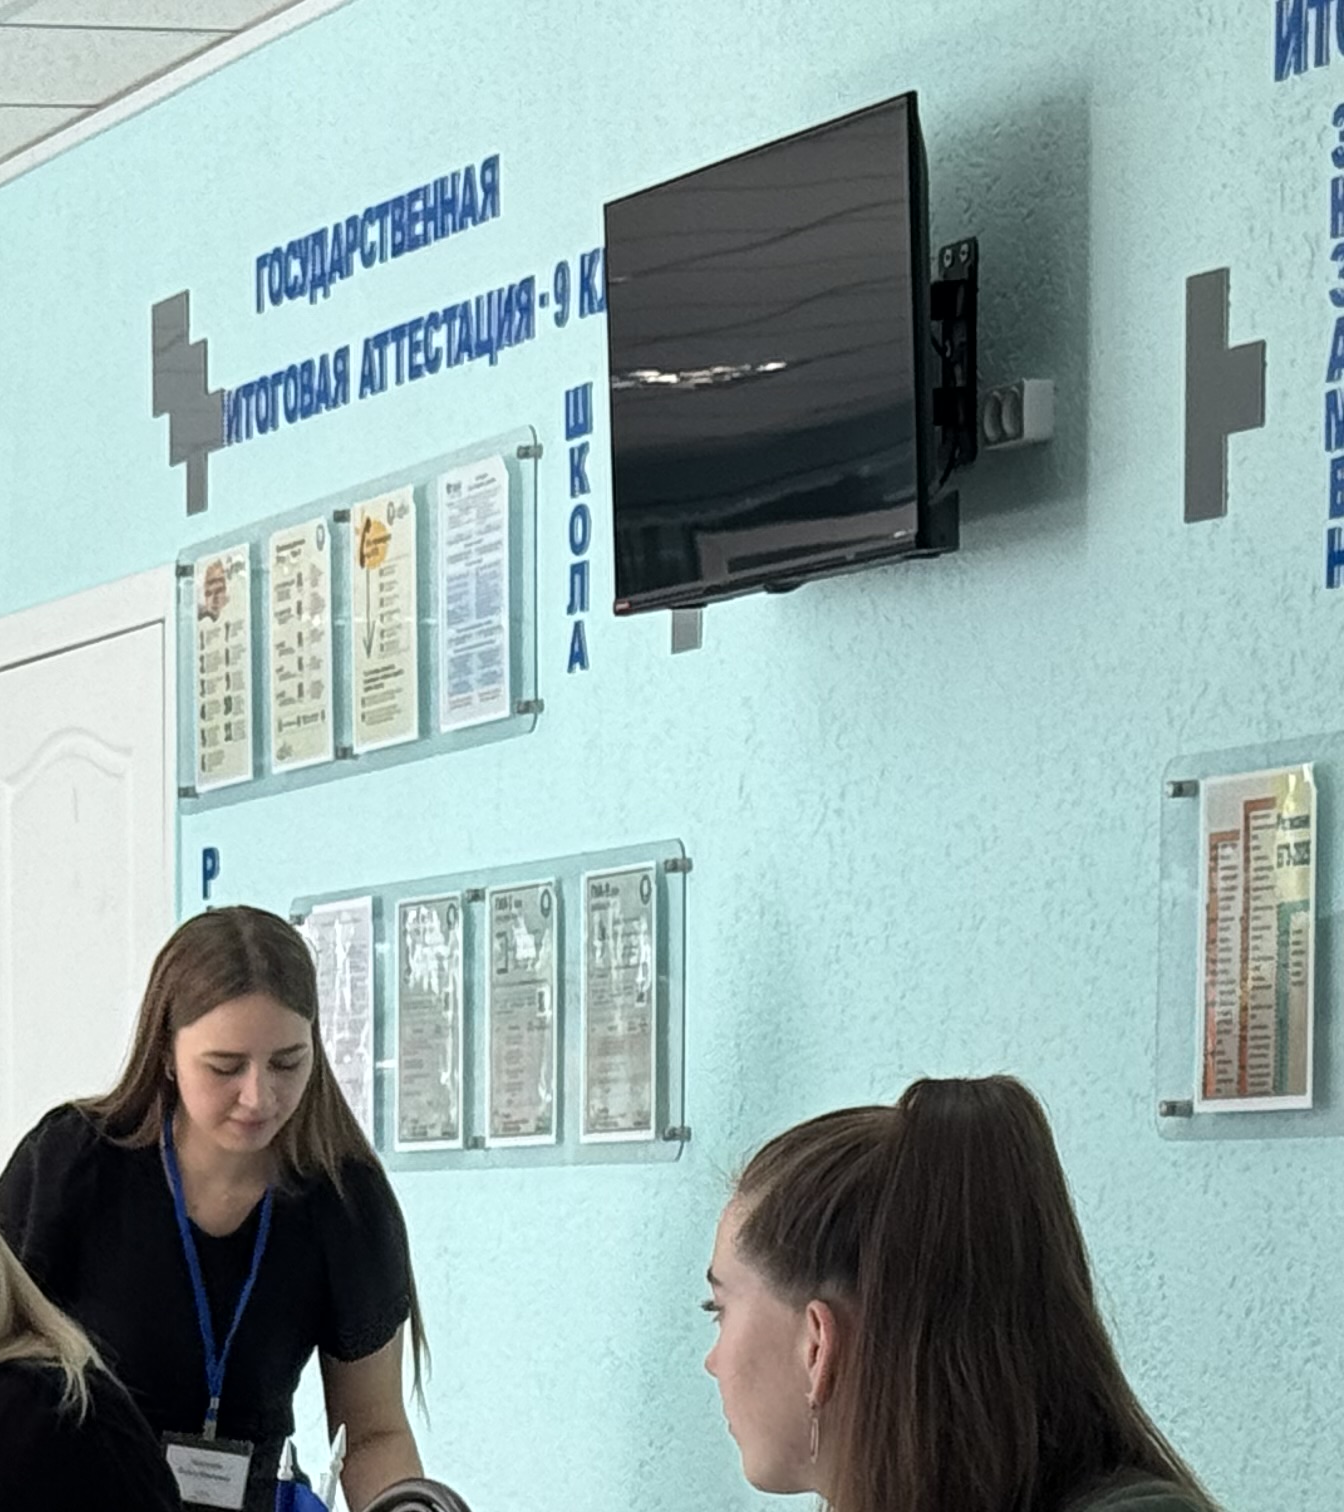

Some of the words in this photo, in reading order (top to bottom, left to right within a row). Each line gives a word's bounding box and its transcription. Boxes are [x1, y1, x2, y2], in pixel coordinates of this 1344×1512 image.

[256, 153, 501, 314] ГОСУДАРСТВЕННАЯ
[224, 344, 350, 447] ИТОГОВАЯ
[565, 381, 593, 674] ШКОЛА
